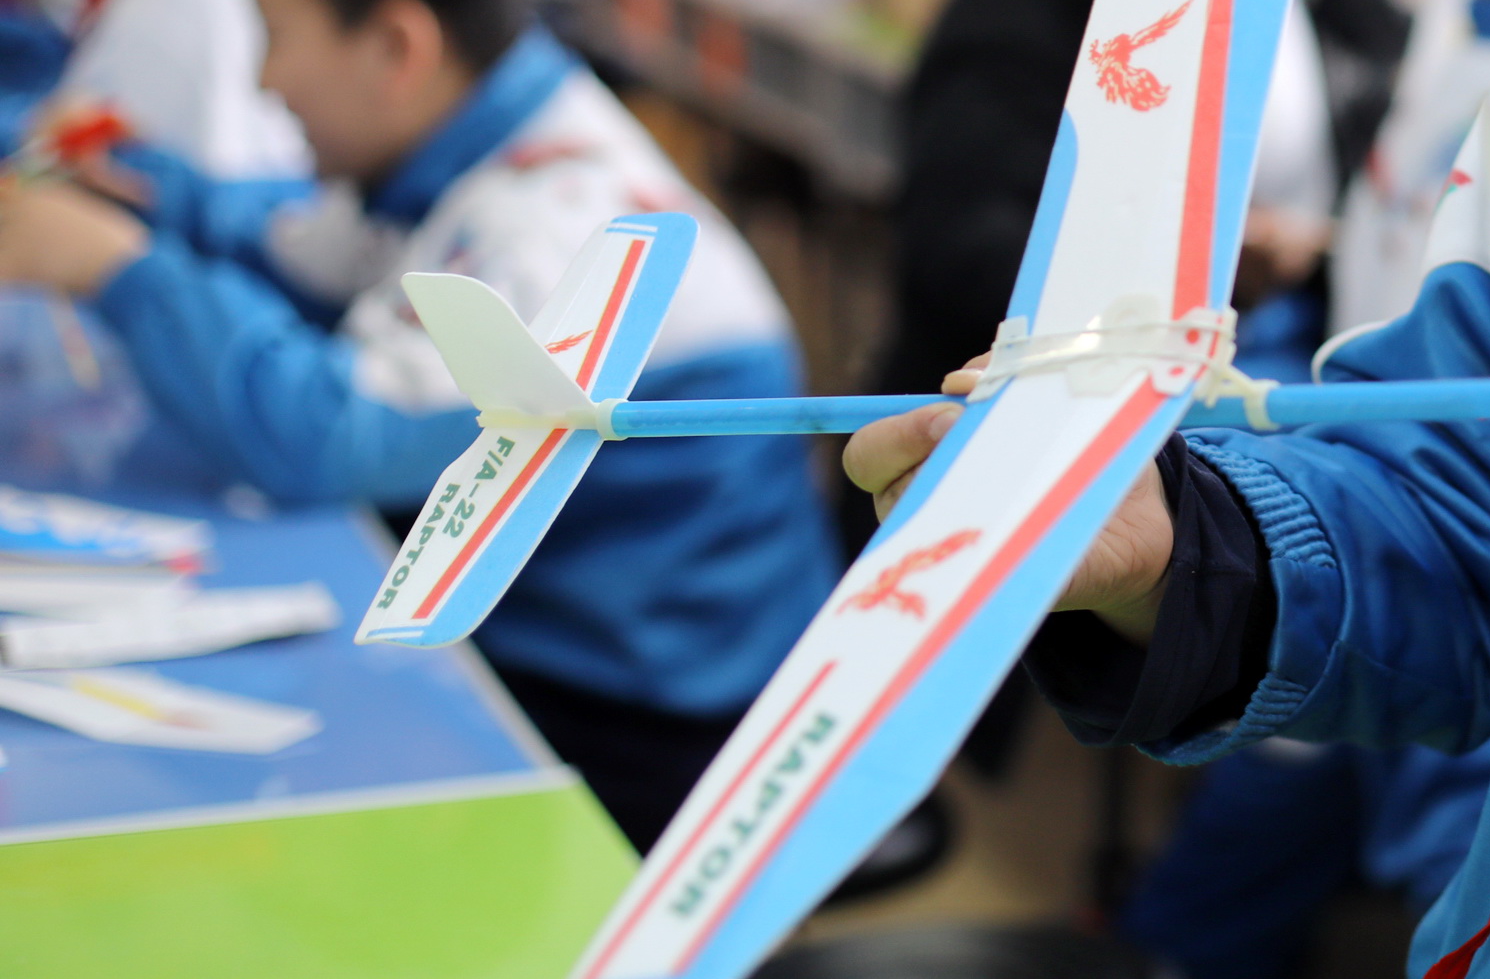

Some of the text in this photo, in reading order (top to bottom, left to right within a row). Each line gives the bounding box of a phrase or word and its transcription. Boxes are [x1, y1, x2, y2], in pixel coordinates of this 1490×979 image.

[376, 483, 461, 610] RAPTOR
[442, 436, 515, 539] F/A-22
[670, 712, 837, 917] RAPTOR
